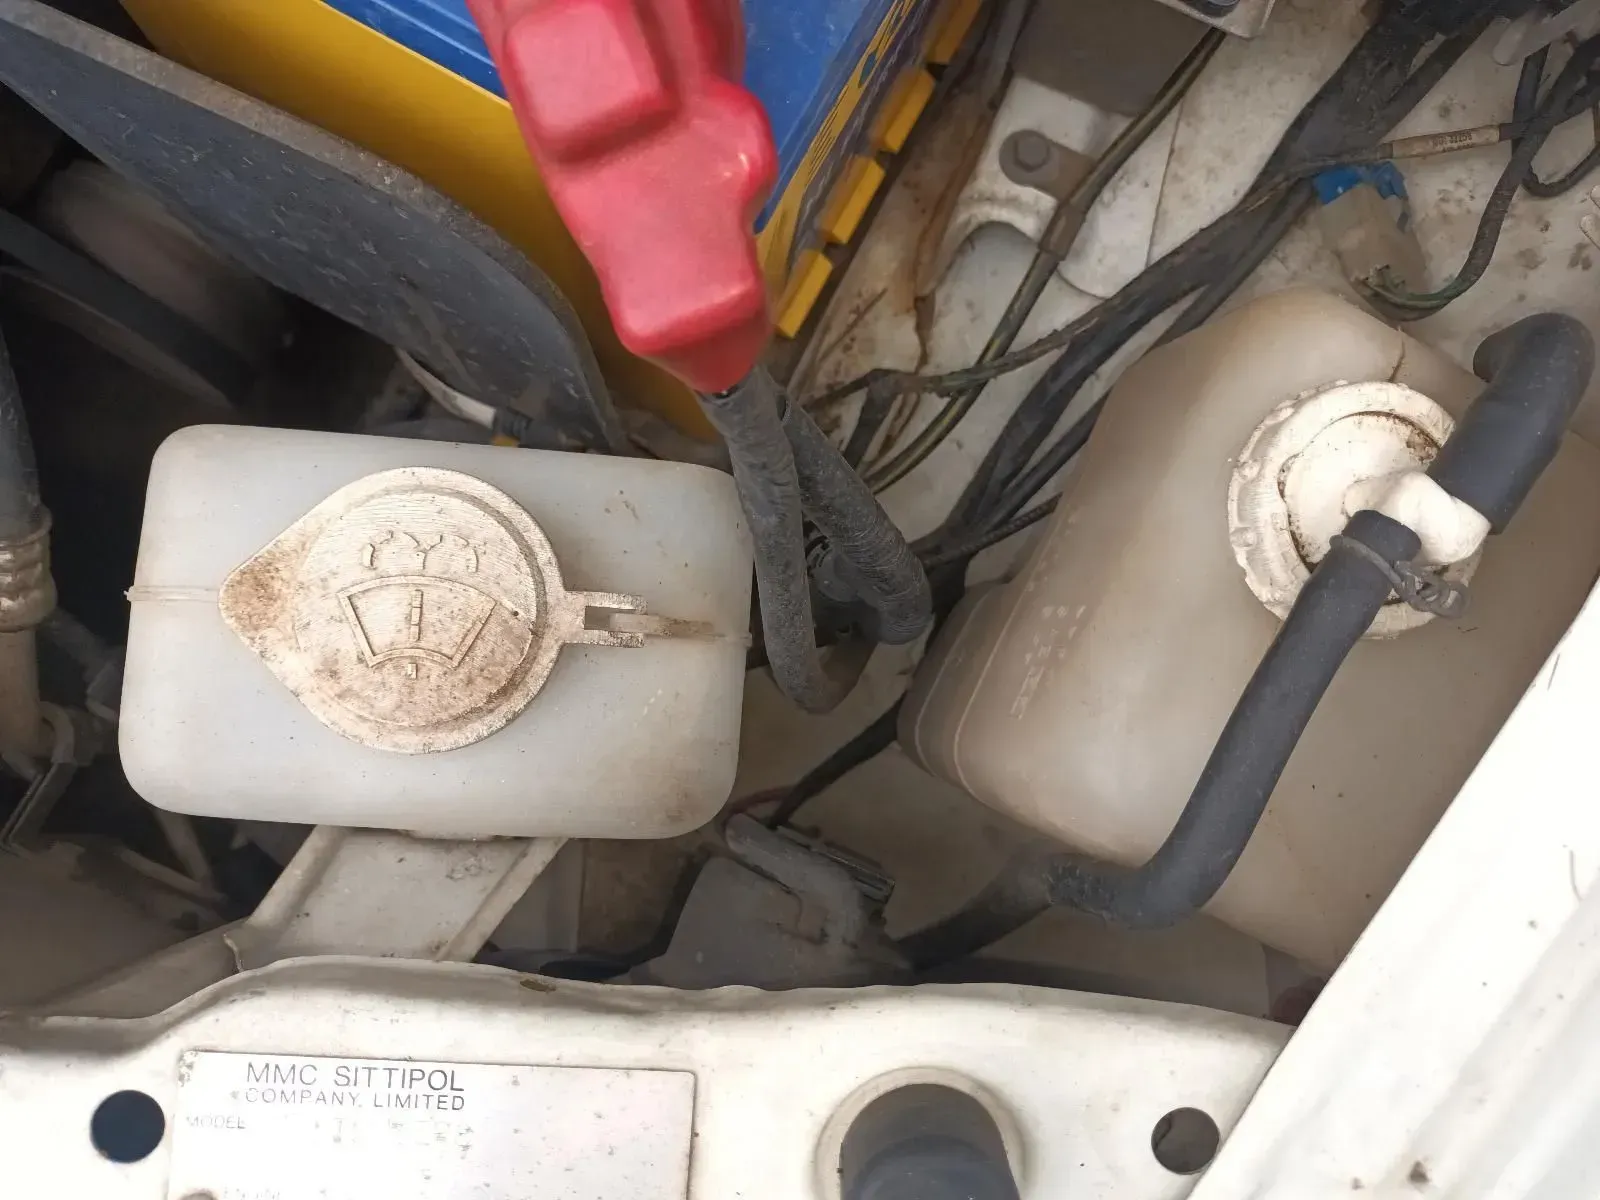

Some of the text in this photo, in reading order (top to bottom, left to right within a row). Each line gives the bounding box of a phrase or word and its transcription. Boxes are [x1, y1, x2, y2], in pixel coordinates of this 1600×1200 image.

[246, 1061, 465, 1091] MMC SITTIPOL
[373, 1093, 465, 1111] LIMITED
[186, 1114, 247, 1129] MODEL
